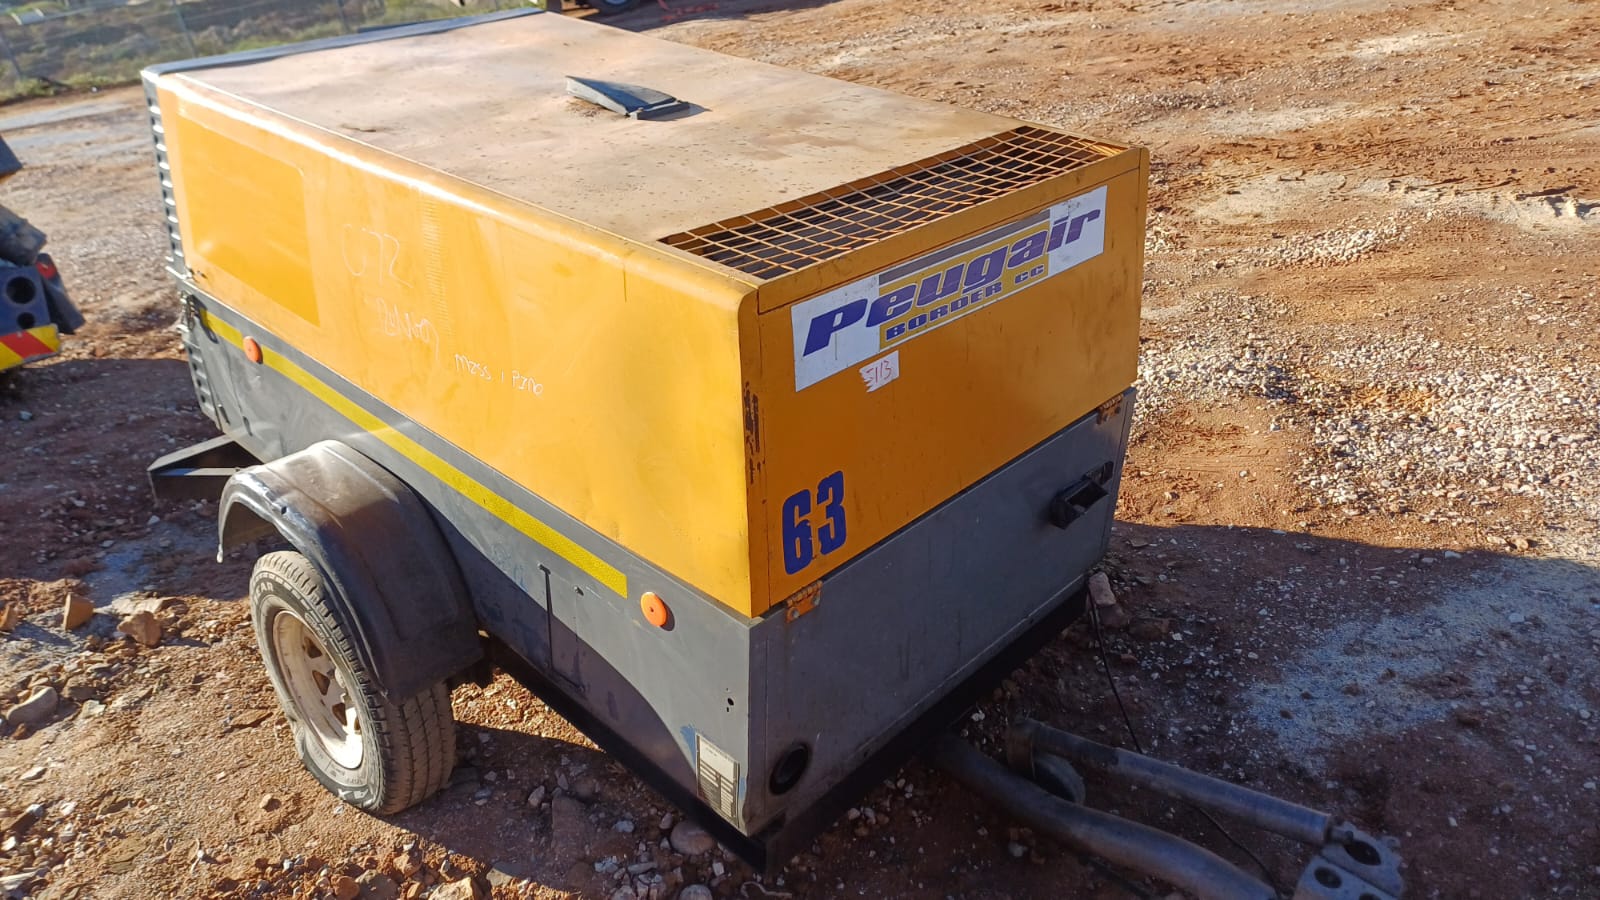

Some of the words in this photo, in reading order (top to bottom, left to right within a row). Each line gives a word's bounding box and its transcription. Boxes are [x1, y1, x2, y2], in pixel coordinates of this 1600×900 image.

[803, 209, 1101, 357] Peugair
[885, 281, 1003, 341] BORDER
[1014, 263, 1045, 284] CC
[782, 470, 847, 575] 63
